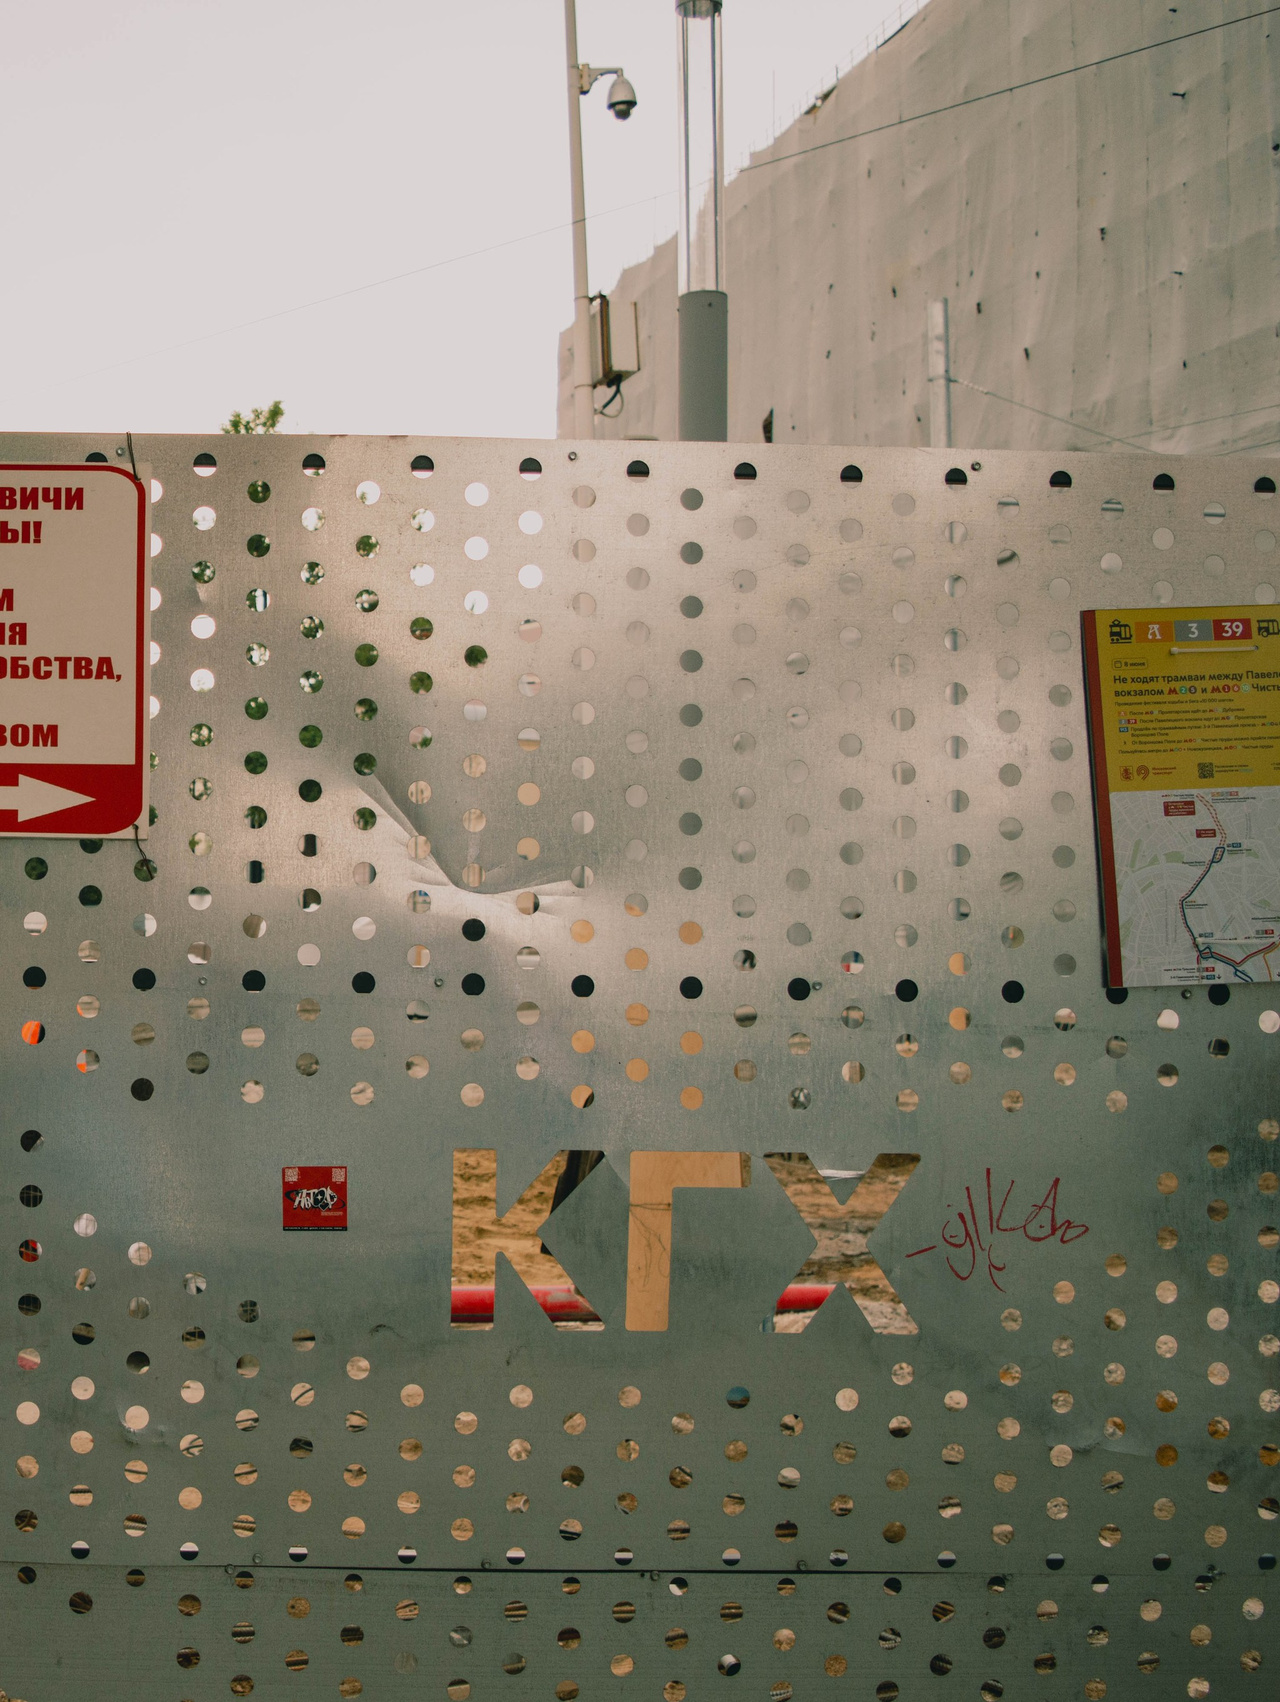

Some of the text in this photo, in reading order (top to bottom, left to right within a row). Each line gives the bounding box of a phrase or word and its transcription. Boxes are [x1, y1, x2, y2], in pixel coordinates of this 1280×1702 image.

[1188, 623, 1198, 638] 3
[1221, 622, 1243, 636] 39
[1114, 675, 1128, 684] Не
[1130, 675, 1159, 684] ходят
[1162, 674, 1206, 684] трамваи
[1208, 672, 1243, 681] между
[1114, 689, 1164, 697] вокзалом
[450, 1148, 921, 1335] КГХ
